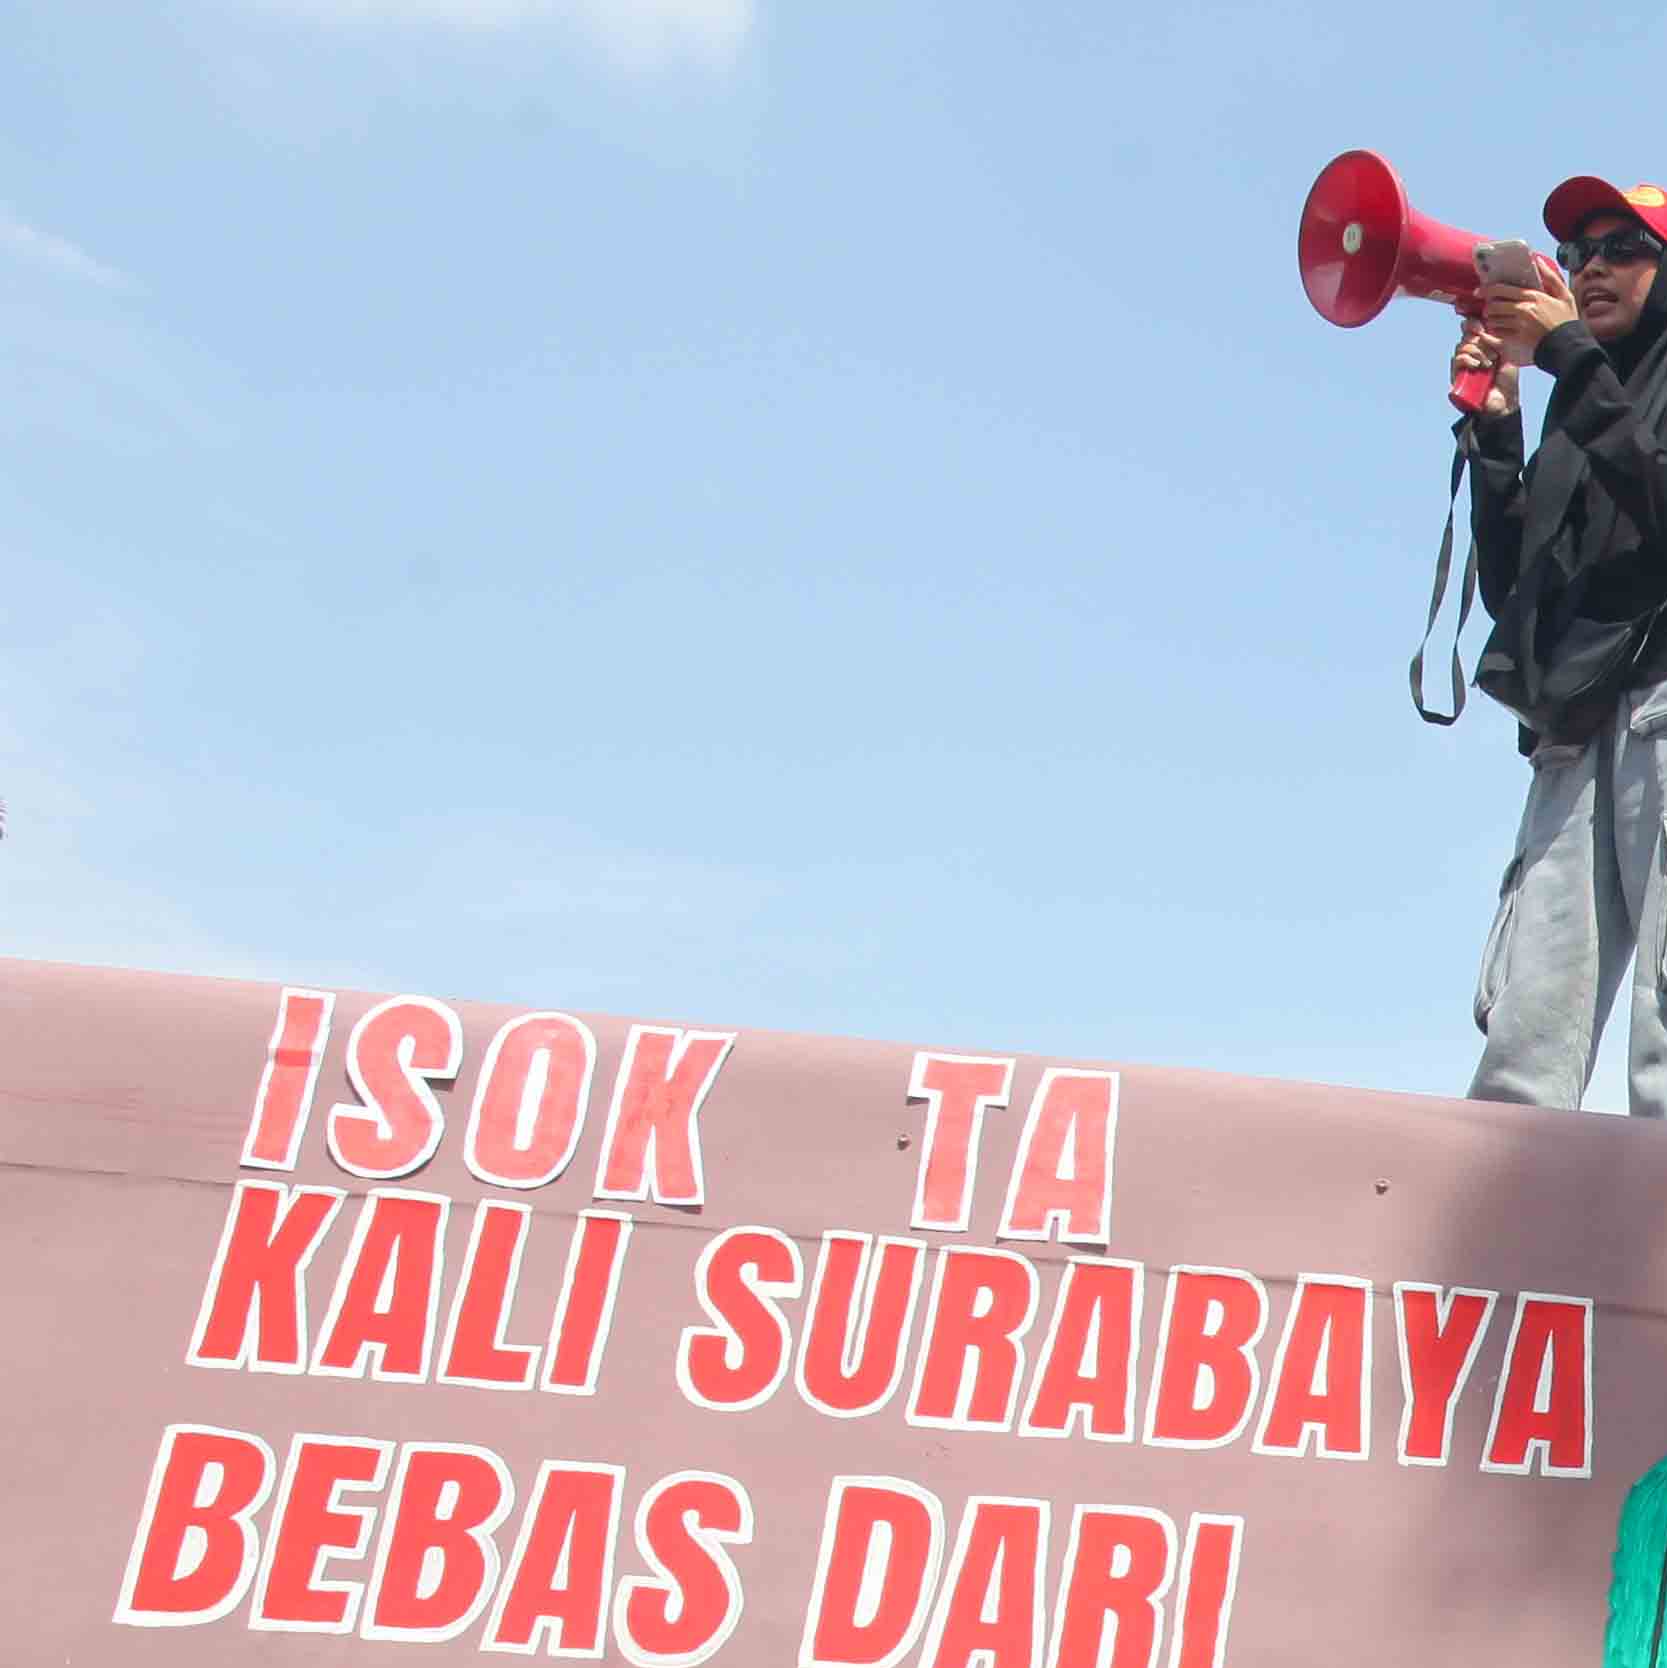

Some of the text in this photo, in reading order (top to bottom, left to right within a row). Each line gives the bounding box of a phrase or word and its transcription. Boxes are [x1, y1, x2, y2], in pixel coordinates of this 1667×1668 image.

[240, 986, 1119, 1245] ISOK TA
[185, 1178, 1595, 1479] KALI SURABAYA
